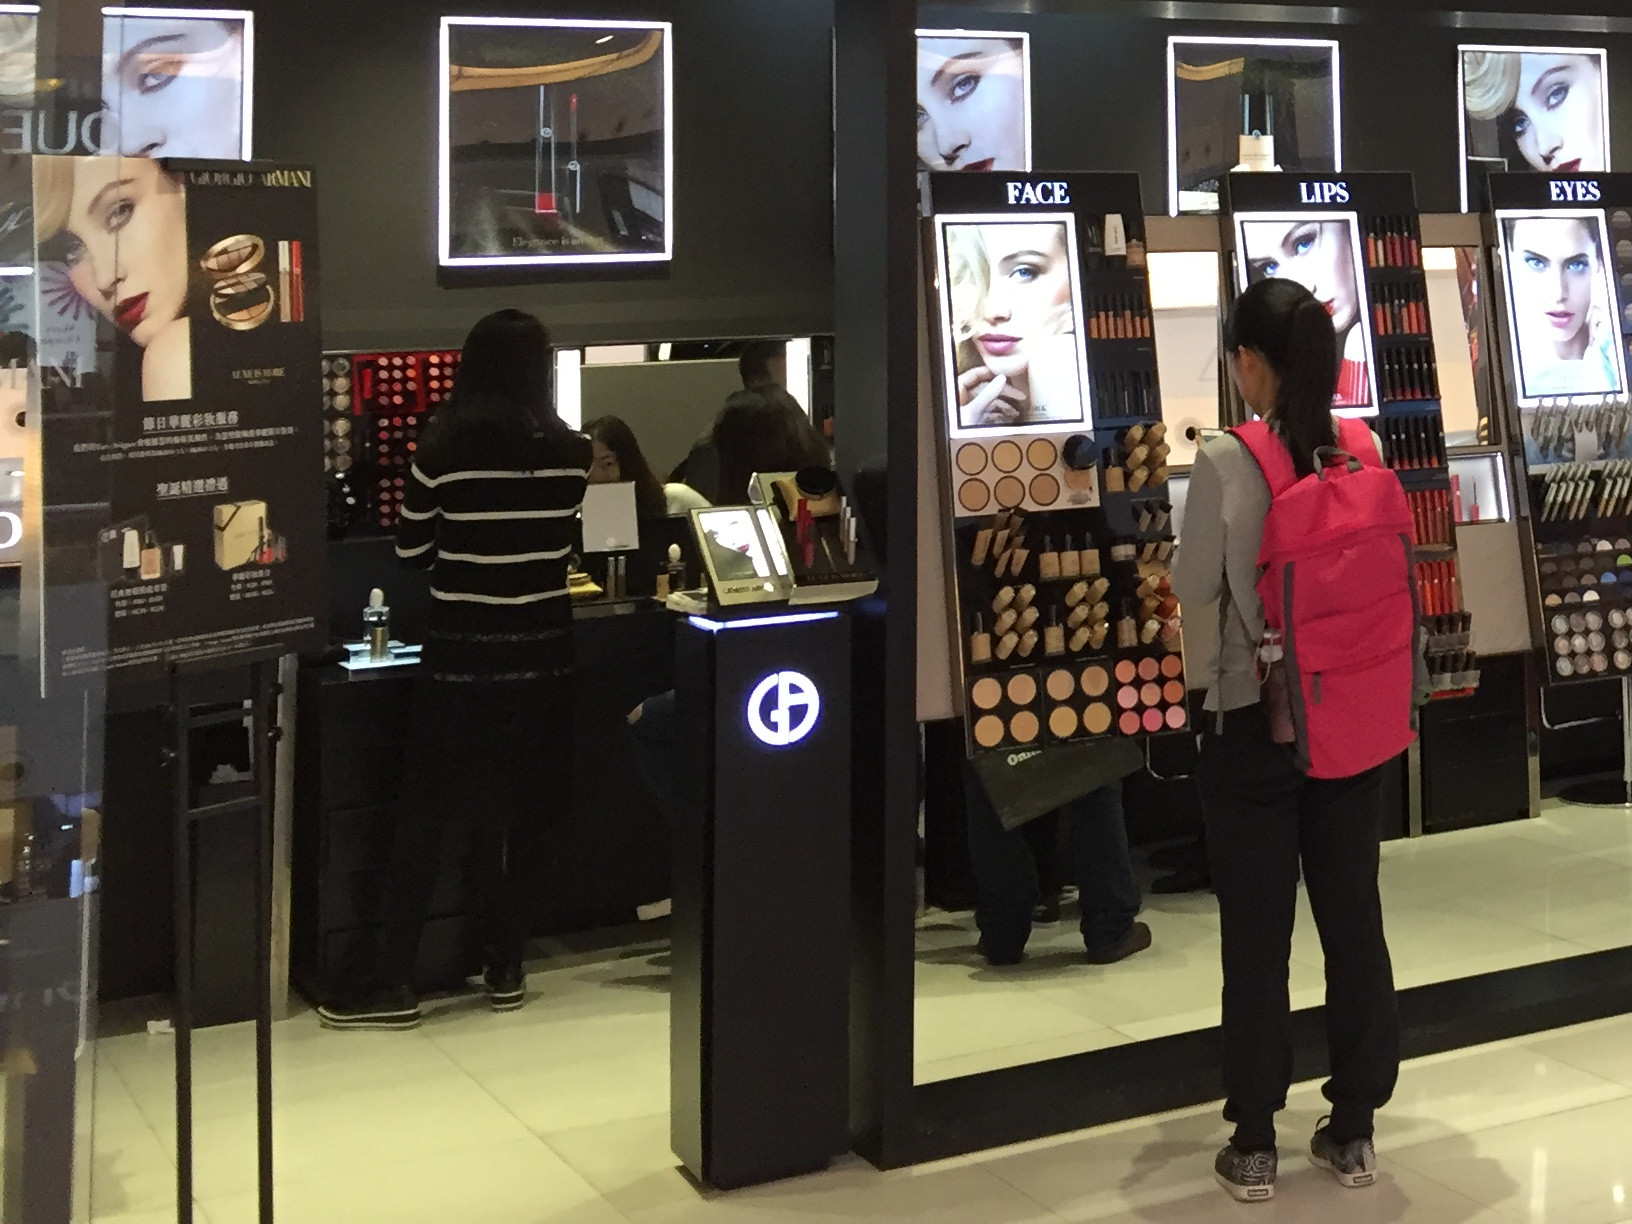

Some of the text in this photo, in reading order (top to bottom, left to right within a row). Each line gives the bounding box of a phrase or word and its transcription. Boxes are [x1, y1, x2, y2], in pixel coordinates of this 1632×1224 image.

[1006, 181, 1071, 205] FACE
[1300, 180, 1350, 205] LIPS
[1550, 179, 1601, 202] EYES
